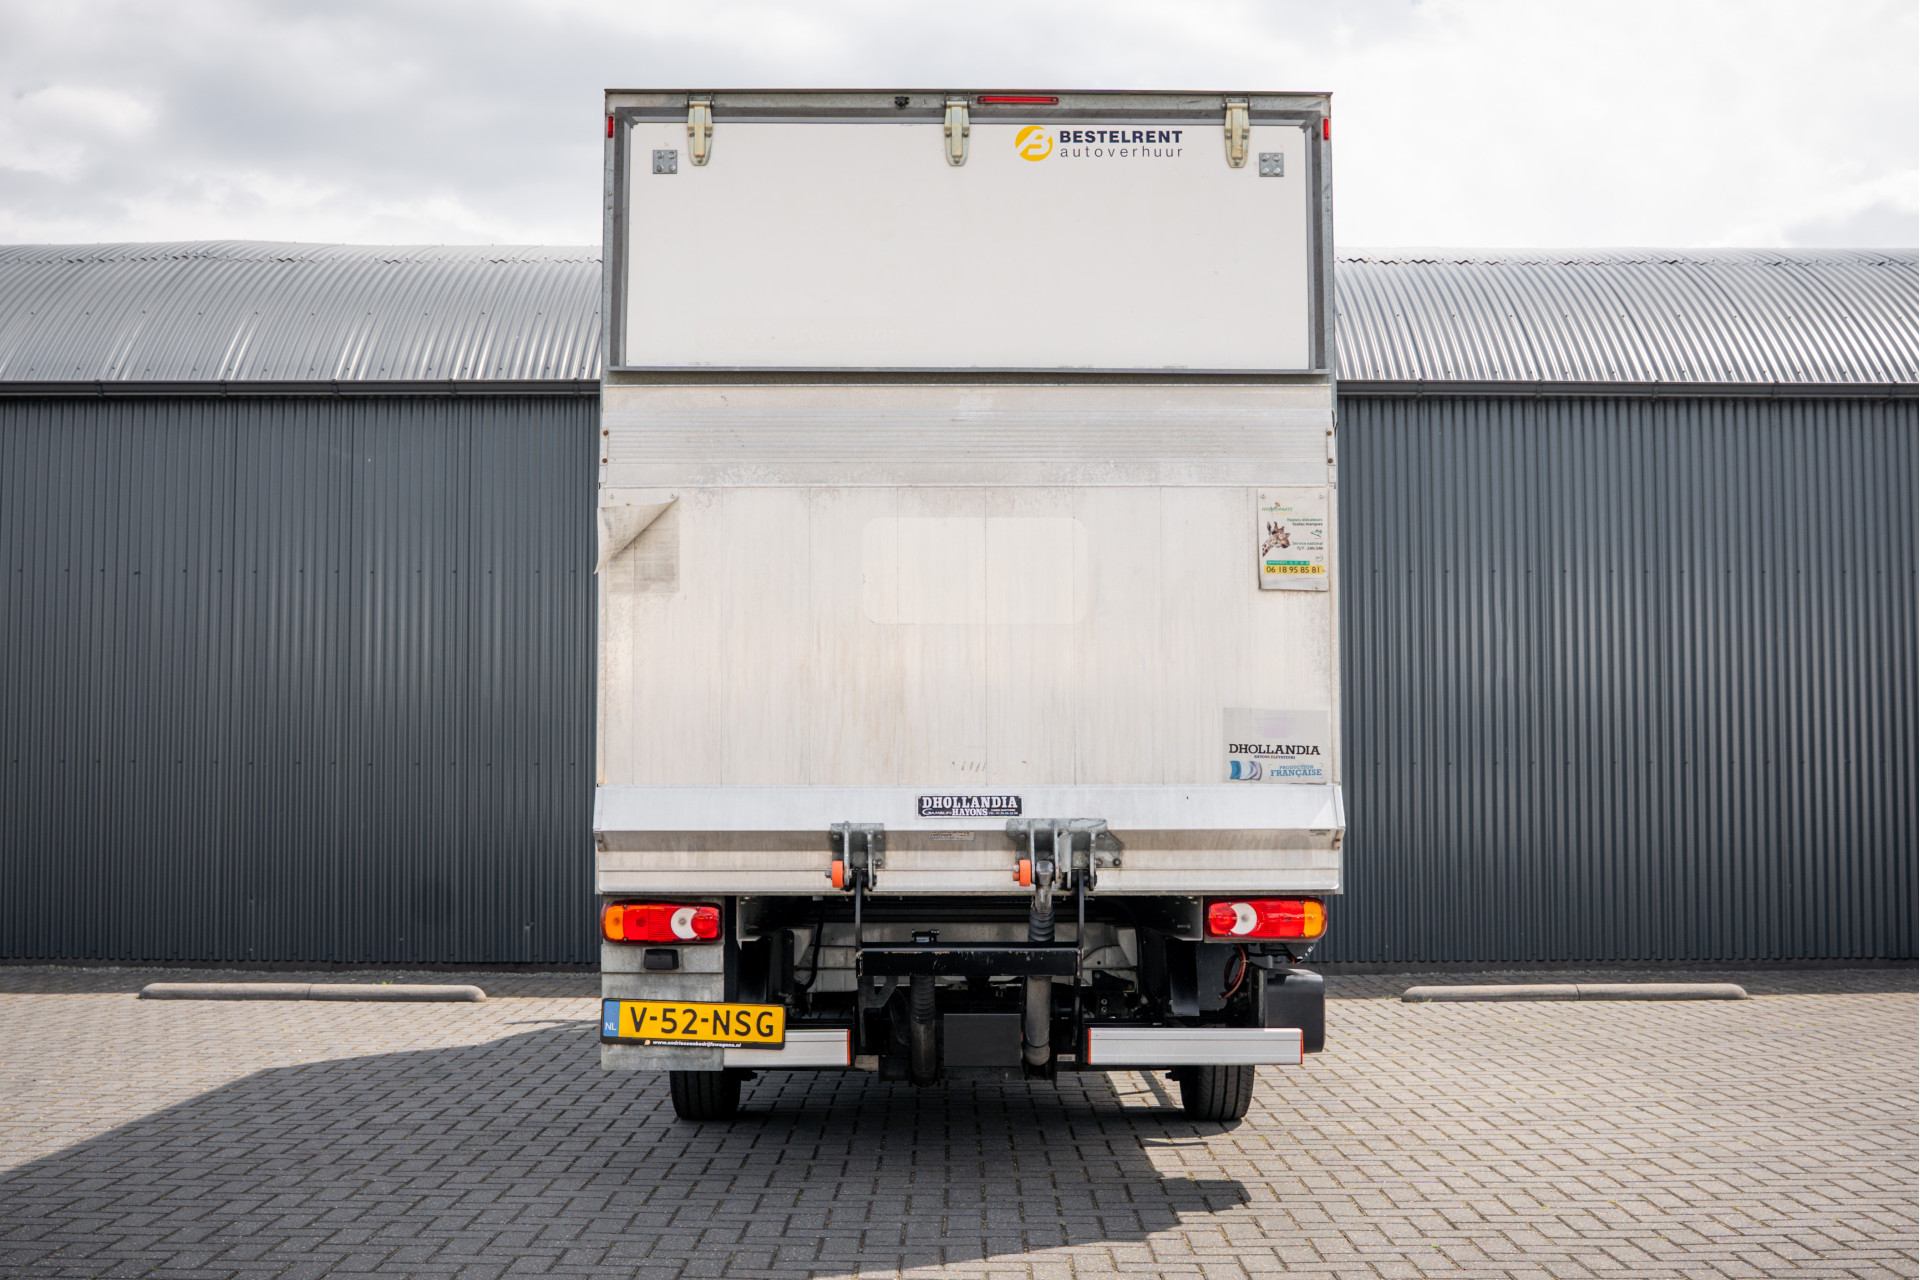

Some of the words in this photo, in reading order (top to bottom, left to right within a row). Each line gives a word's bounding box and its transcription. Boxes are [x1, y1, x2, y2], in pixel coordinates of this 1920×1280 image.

[1059, 130, 1183, 144] BESTELRENT
[1060, 146, 1183, 158] autoverhuur
[1229, 743, 1321, 755] DHOLLANDIA
[1270, 769, 1322, 778] FRANÇAISE
[922, 796, 1018, 808] DHOLLANDIA
[952, 808, 988, 816] HAYONS
[605, 1022, 617, 1031] NL
[630, 1006, 774, 1037] V-52-NSG
[652, 1040, 742, 1049] www.andriessenbedrijfswagens.nl
